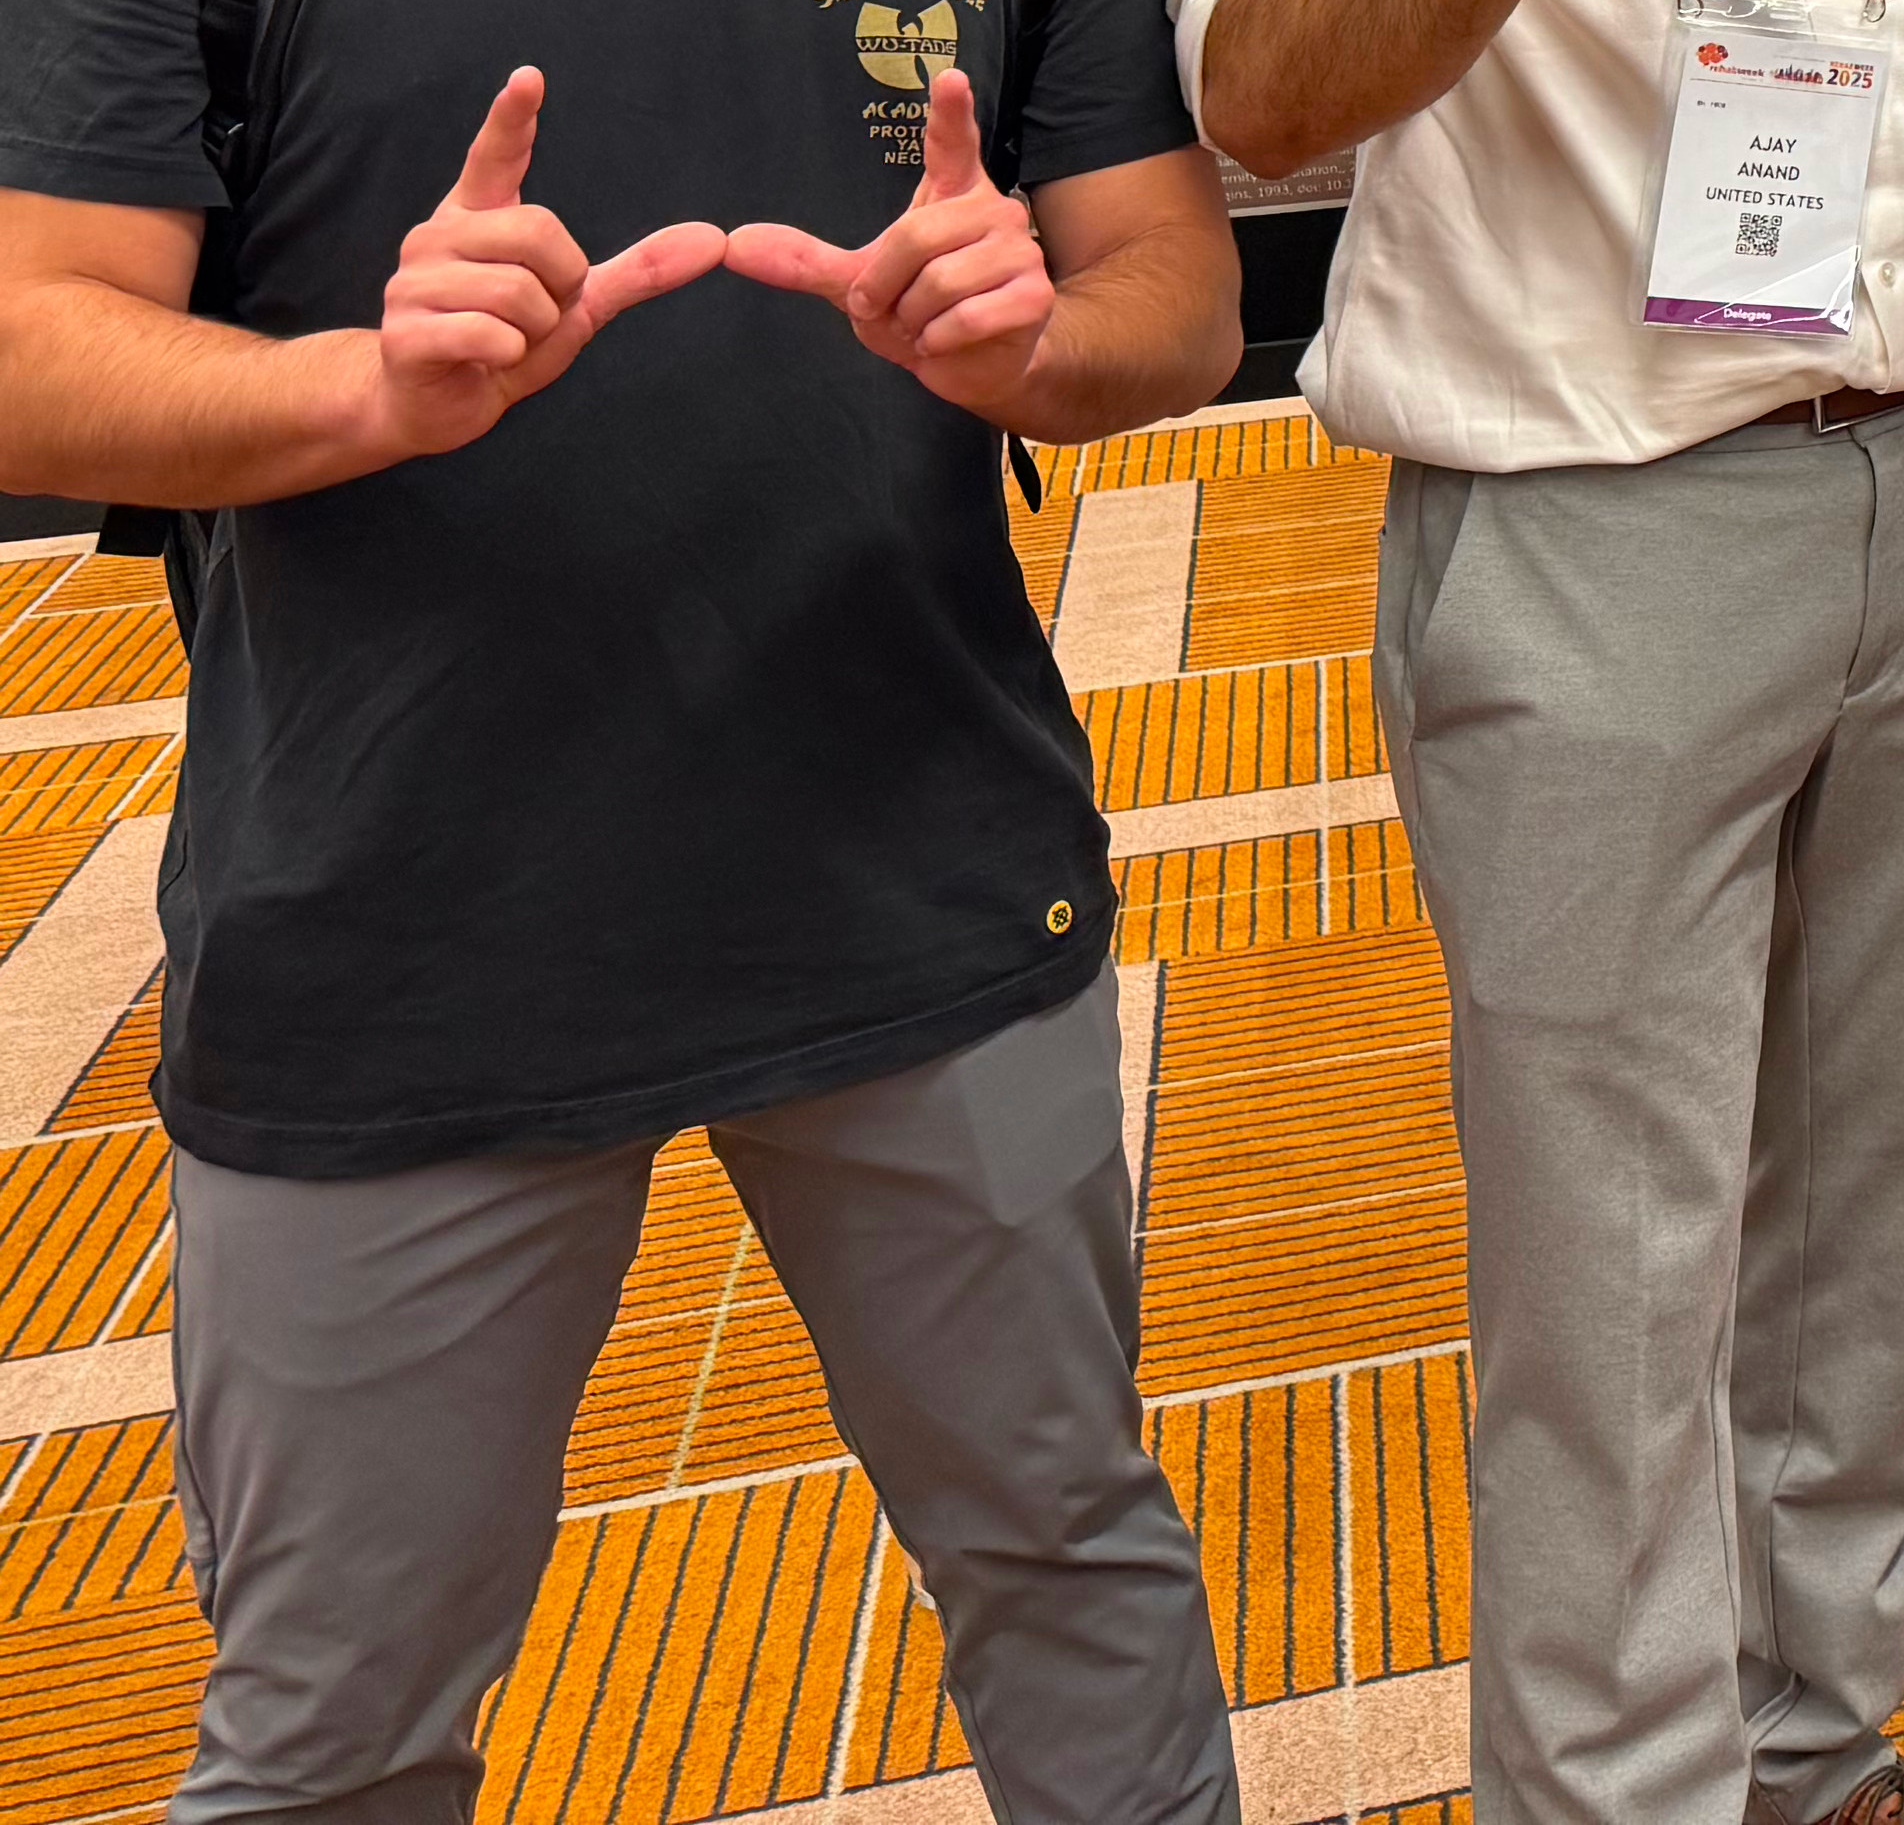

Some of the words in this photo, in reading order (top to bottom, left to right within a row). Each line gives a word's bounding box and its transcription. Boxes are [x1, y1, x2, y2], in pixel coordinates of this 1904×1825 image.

[856, 37, 957, 54] WU-TANG
[1826, 68, 1873, 90] 2025
[1749, 135, 1797, 154] AJAY
[884, 151, 922, 164] NEC
[1737, 161, 1800, 181] ANAND
[1706, 186, 1762, 203] UNITED
[1767, 192, 1823, 210] STATES
[1723, 308, 1772, 322] Delegate
